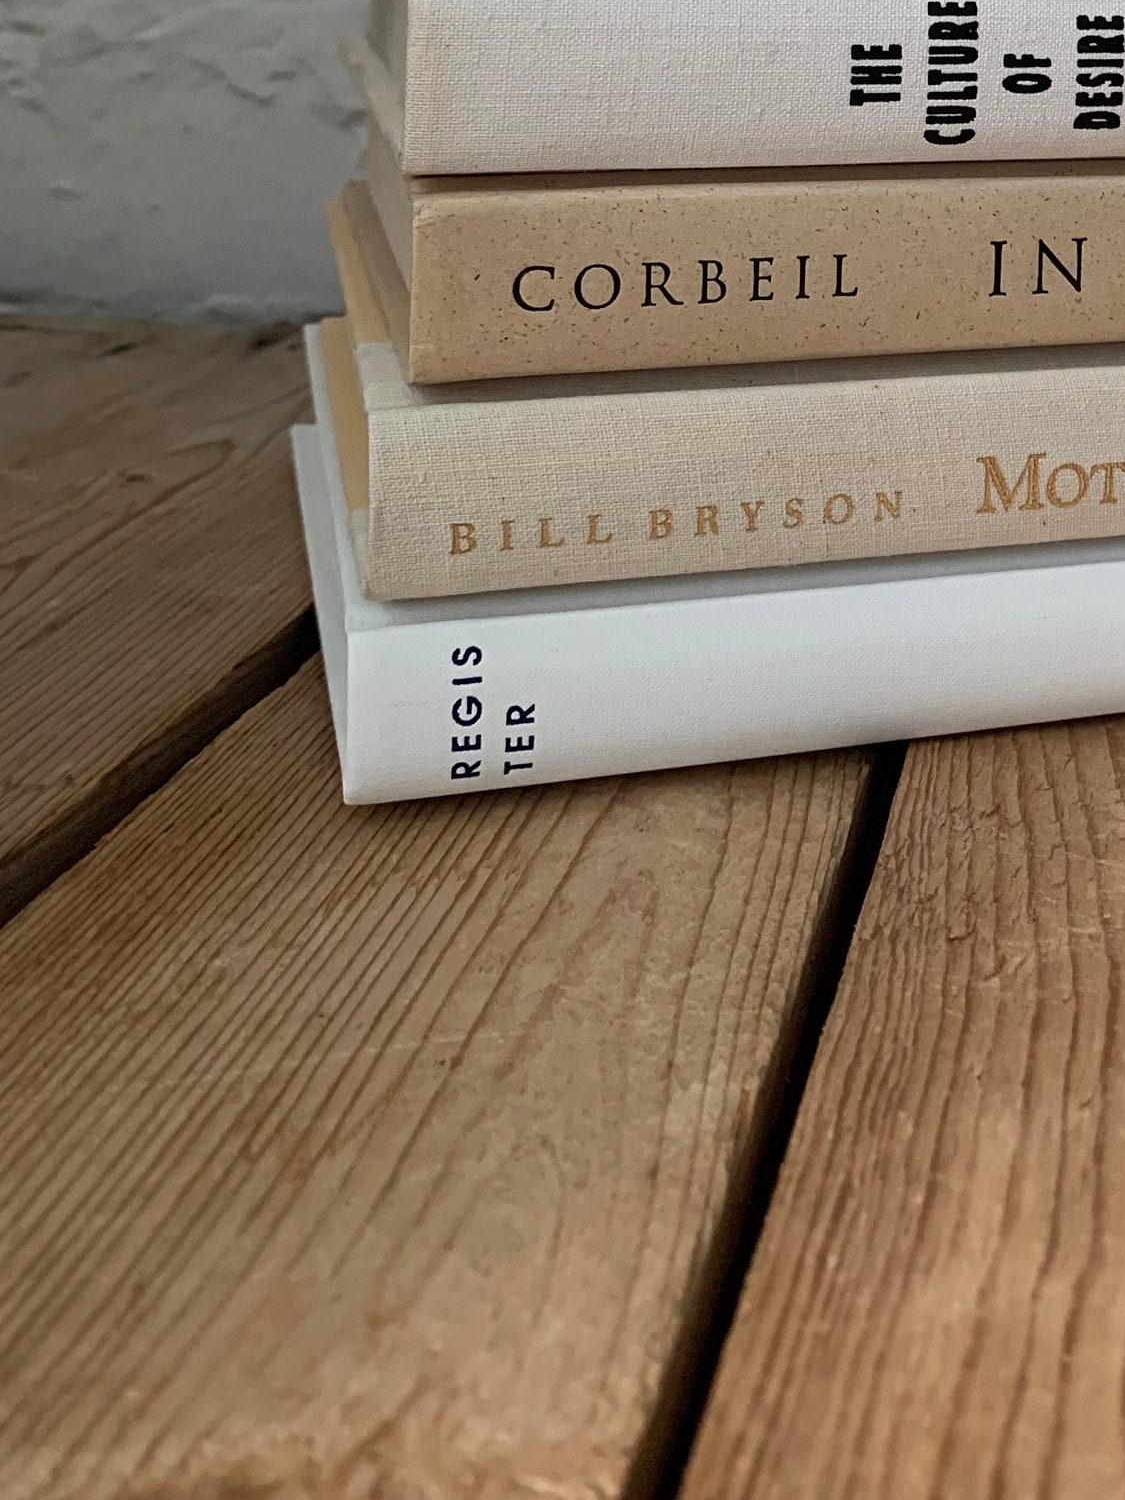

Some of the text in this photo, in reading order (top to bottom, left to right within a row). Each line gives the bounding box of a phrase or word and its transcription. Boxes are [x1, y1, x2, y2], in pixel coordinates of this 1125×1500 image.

[849, 44, 902, 106] THE
[923, 2, 979, 145] CULTURE
[1002, 54, 1052, 94] OF
[1073, 15, 1125, 130] DESIRE
[512, 254, 858, 311] CORBEIL
[989, 237, 1087, 297] IN
[449, 491, 902, 556] BILL BRYSON
[451, 646, 482, 780] REGIS
[503, 704, 535, 775] TER
